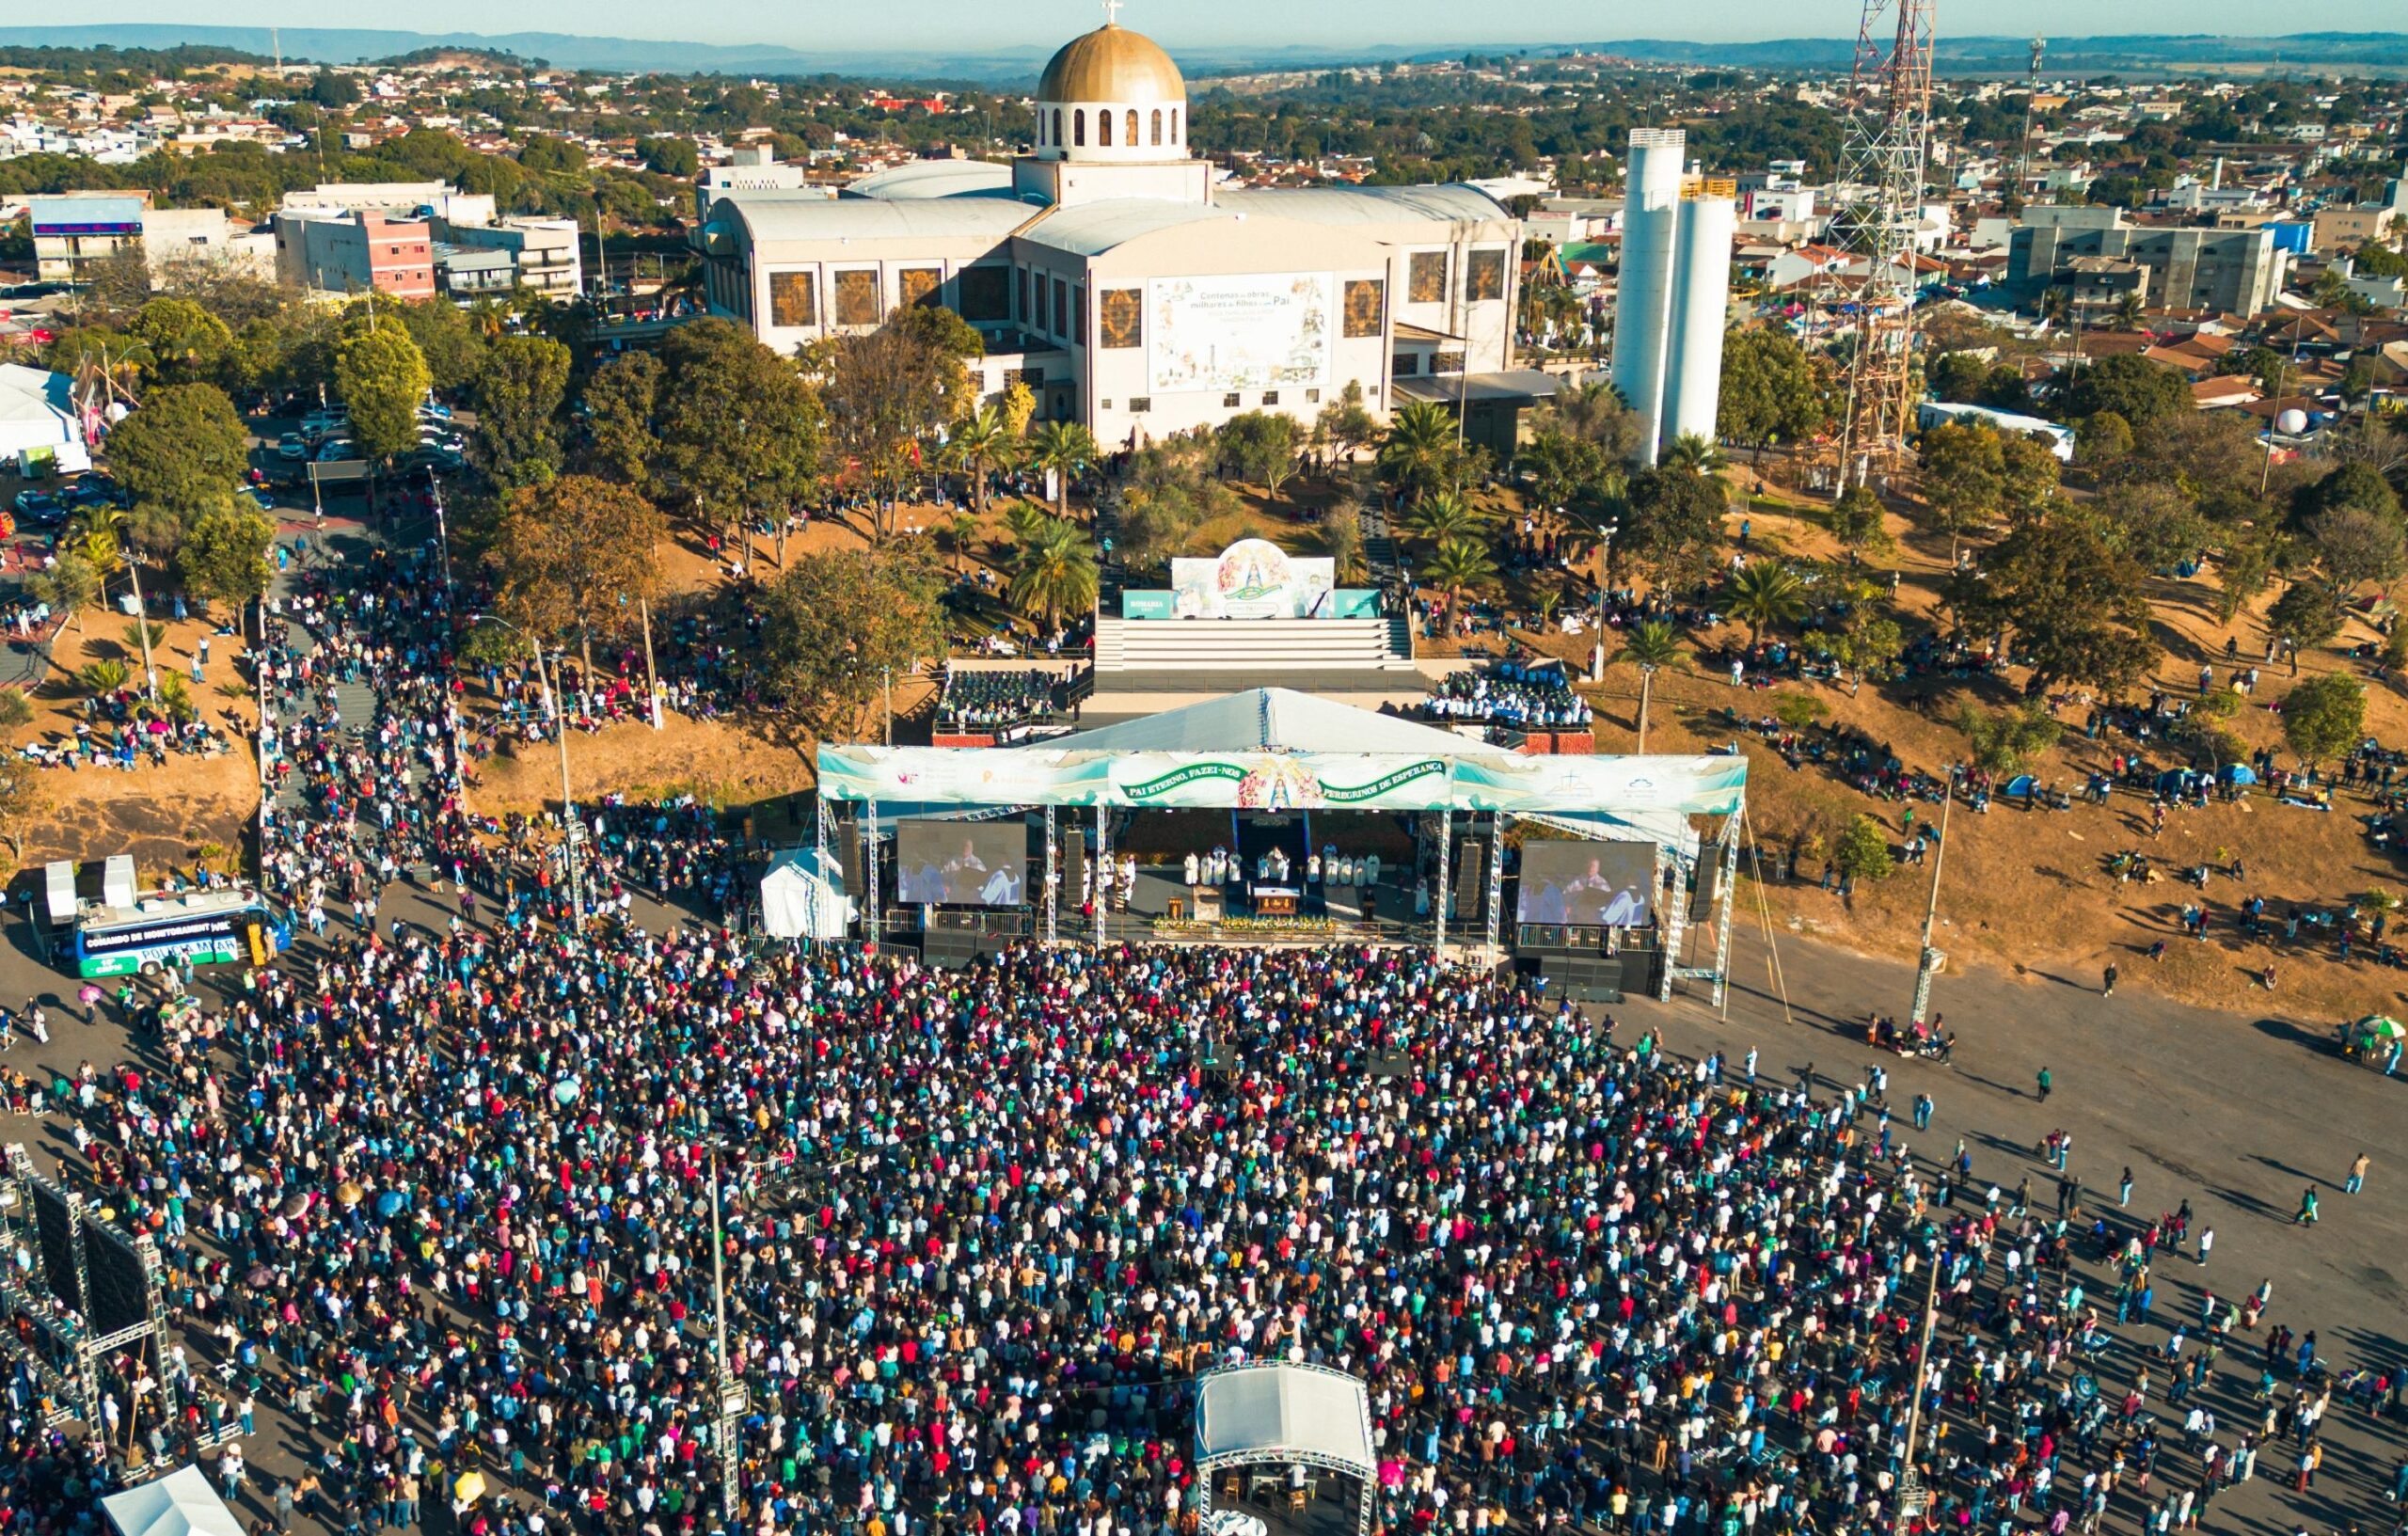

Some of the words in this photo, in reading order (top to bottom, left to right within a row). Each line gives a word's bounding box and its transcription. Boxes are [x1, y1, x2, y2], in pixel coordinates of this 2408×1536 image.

[1323, 785, 1377, 799] PEREGRINOS
[1379, 779, 1391, 790] DE
[1391, 762, 1442, 784] ESPERANÇA
[1129, 787, 1147, 796] PAI
[87, 936, 130, 948] COMANDO
[130, 932, 143, 942] DE
